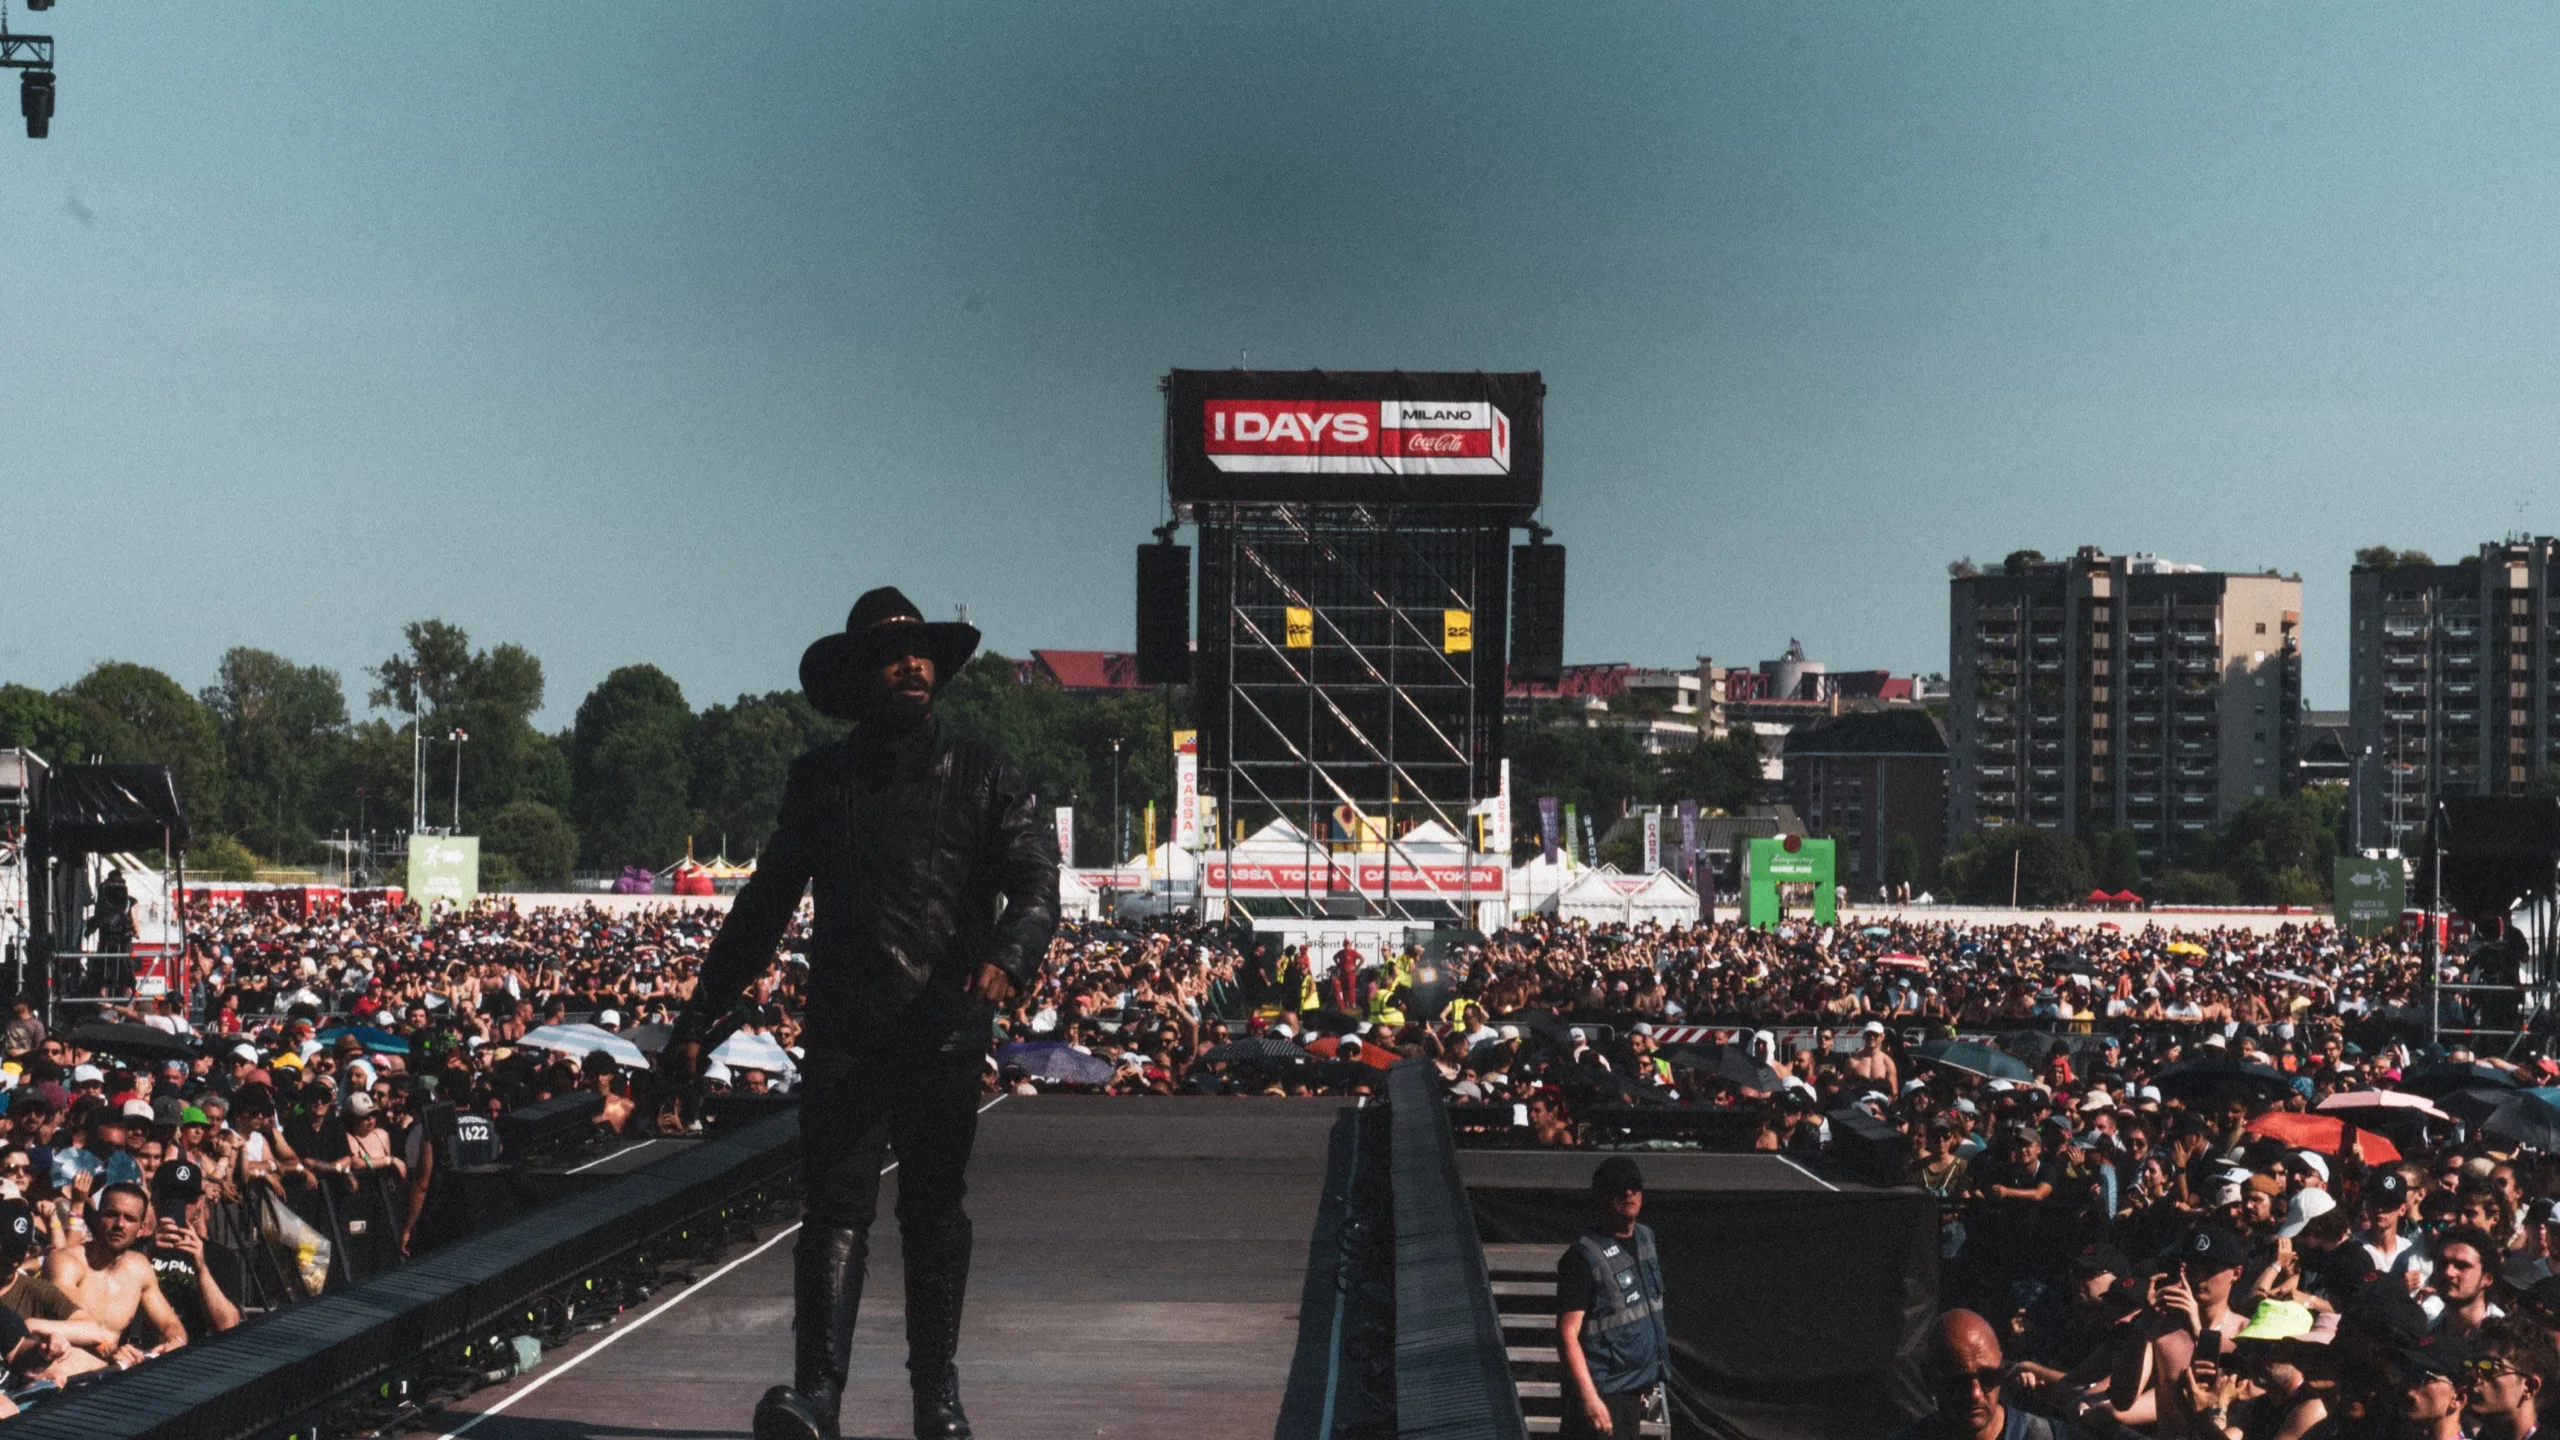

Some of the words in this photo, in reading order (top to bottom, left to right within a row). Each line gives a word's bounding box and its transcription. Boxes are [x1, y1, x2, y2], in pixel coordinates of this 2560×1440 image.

[1403, 410, 1472, 420] MILANO
[1215, 412, 1225, 440] I
[1235, 412, 1369, 442] DAYS
[1448, 627, 1469, 637] 22
[1184, 772, 1194, 831] CASSA
[1648, 823, 1656, 862] CASSA
[1213, 868, 1274, 881] CASSA
[1280, 869, 1340, 881] TOKEN
[459, 1126, 489, 1141] 1622
